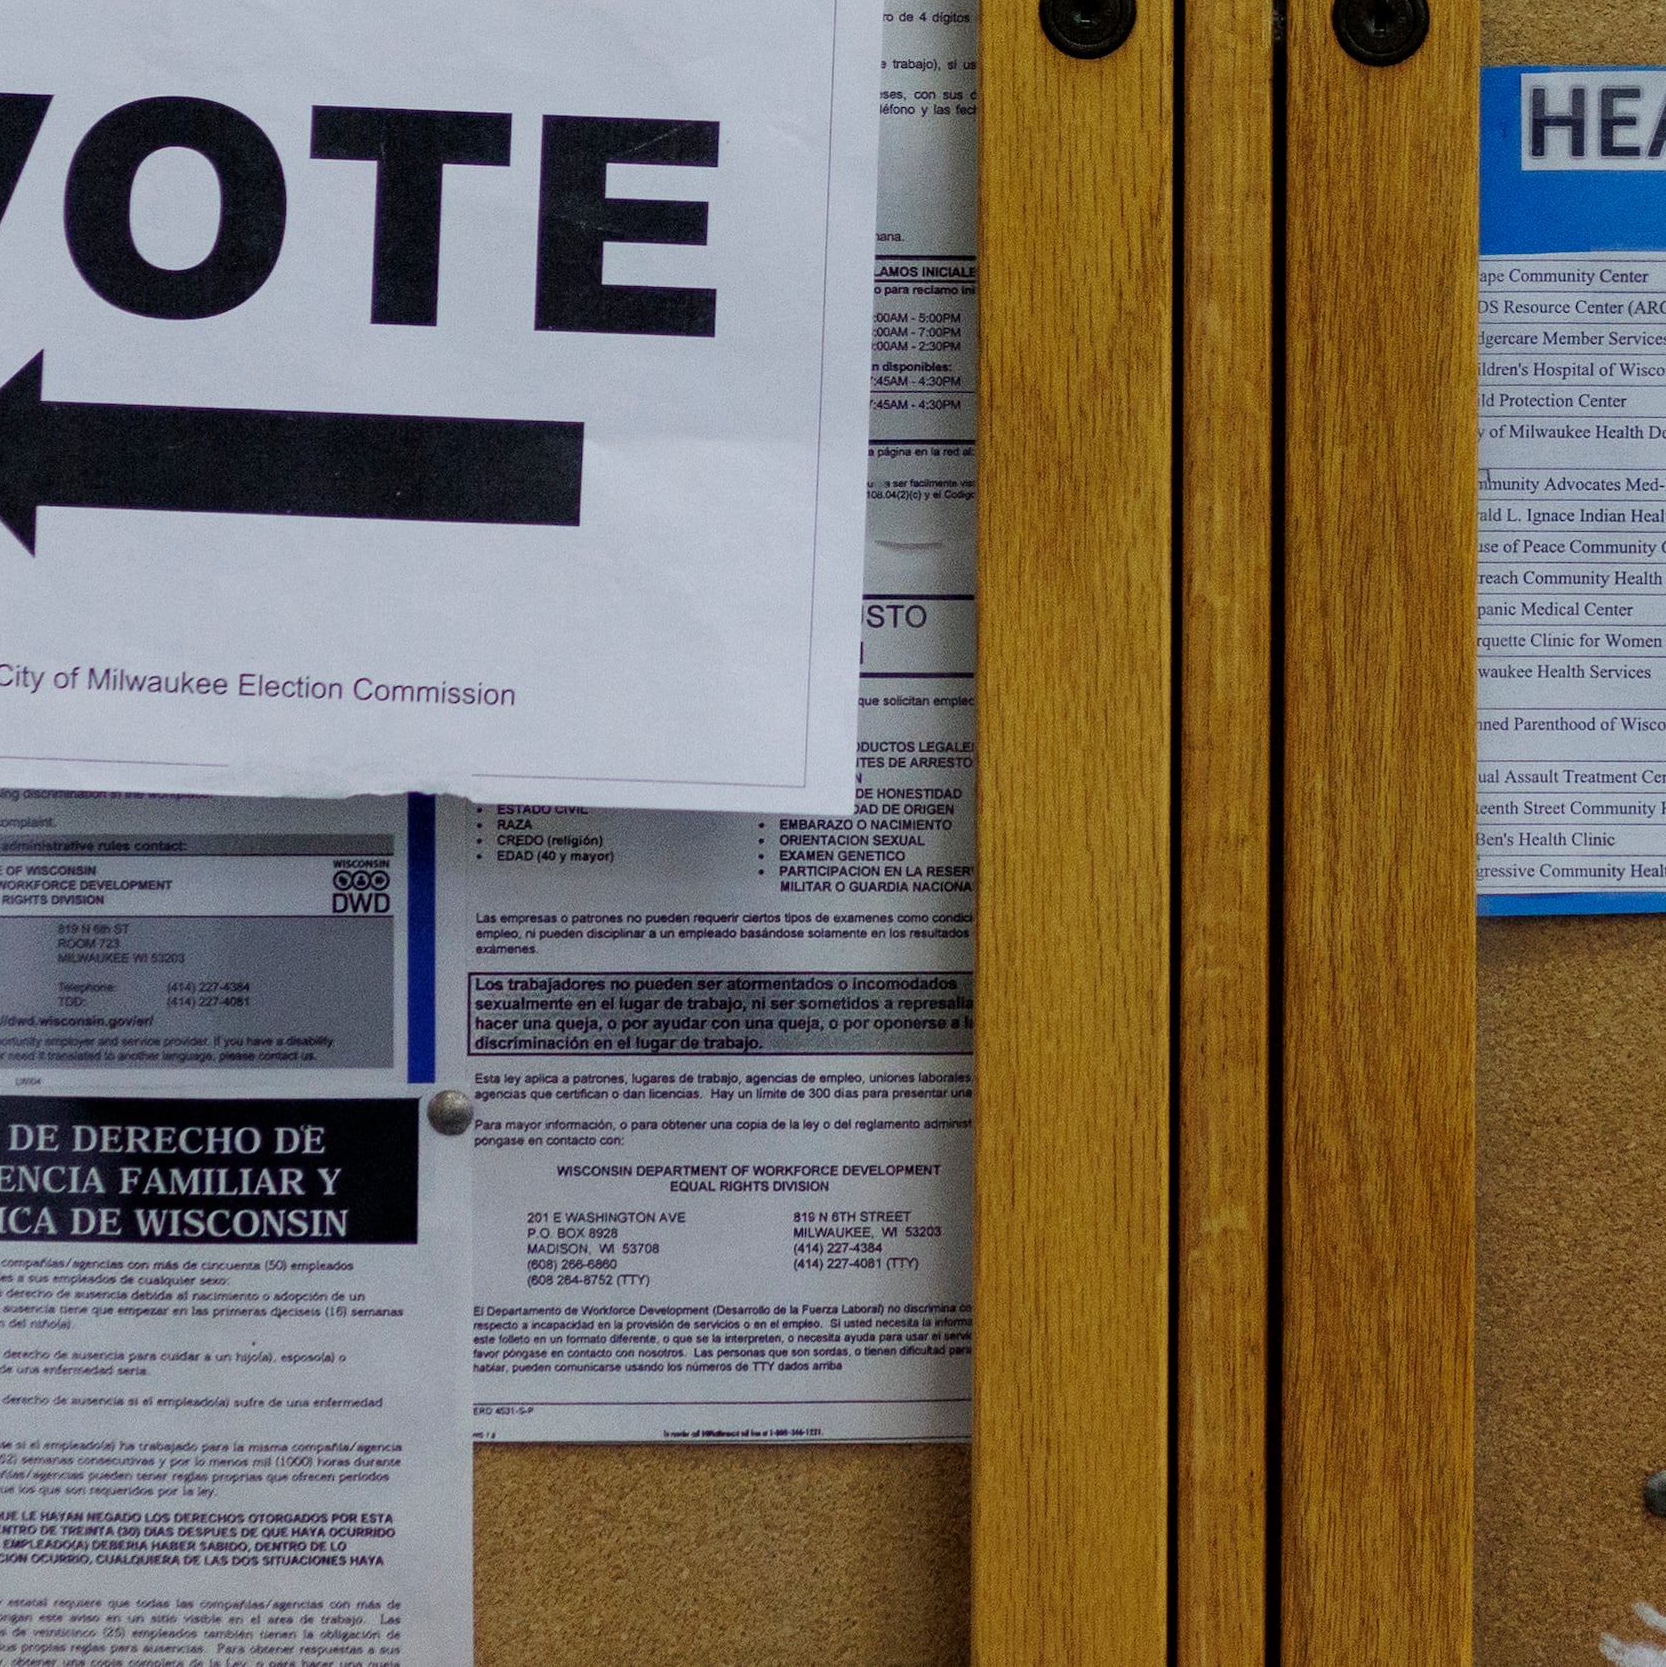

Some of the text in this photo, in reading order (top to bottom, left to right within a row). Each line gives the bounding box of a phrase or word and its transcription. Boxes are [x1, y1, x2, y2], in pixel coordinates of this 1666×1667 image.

[1543, 476, 1622, 492] Advocates
[53, 665, 81, 690] of
[87, 666, 229, 696] Milwaukee
[238, 672, 344, 700] Election
[352, 676, 516, 707] Commission
[8, 1123, 60, 1152] DE
[72, 1124, 262, 1155] DERECHO
[274, 1124, 326, 1154] DE
[119, 1166, 305, 1196] FAMILIAR
[317, 1167, 342, 1196] Y
[70, 1207, 122, 1236] DE
[135, 1208, 348, 1238] WISCONSIN
[793, 1242, 883, 1255] (414) 227-4384
